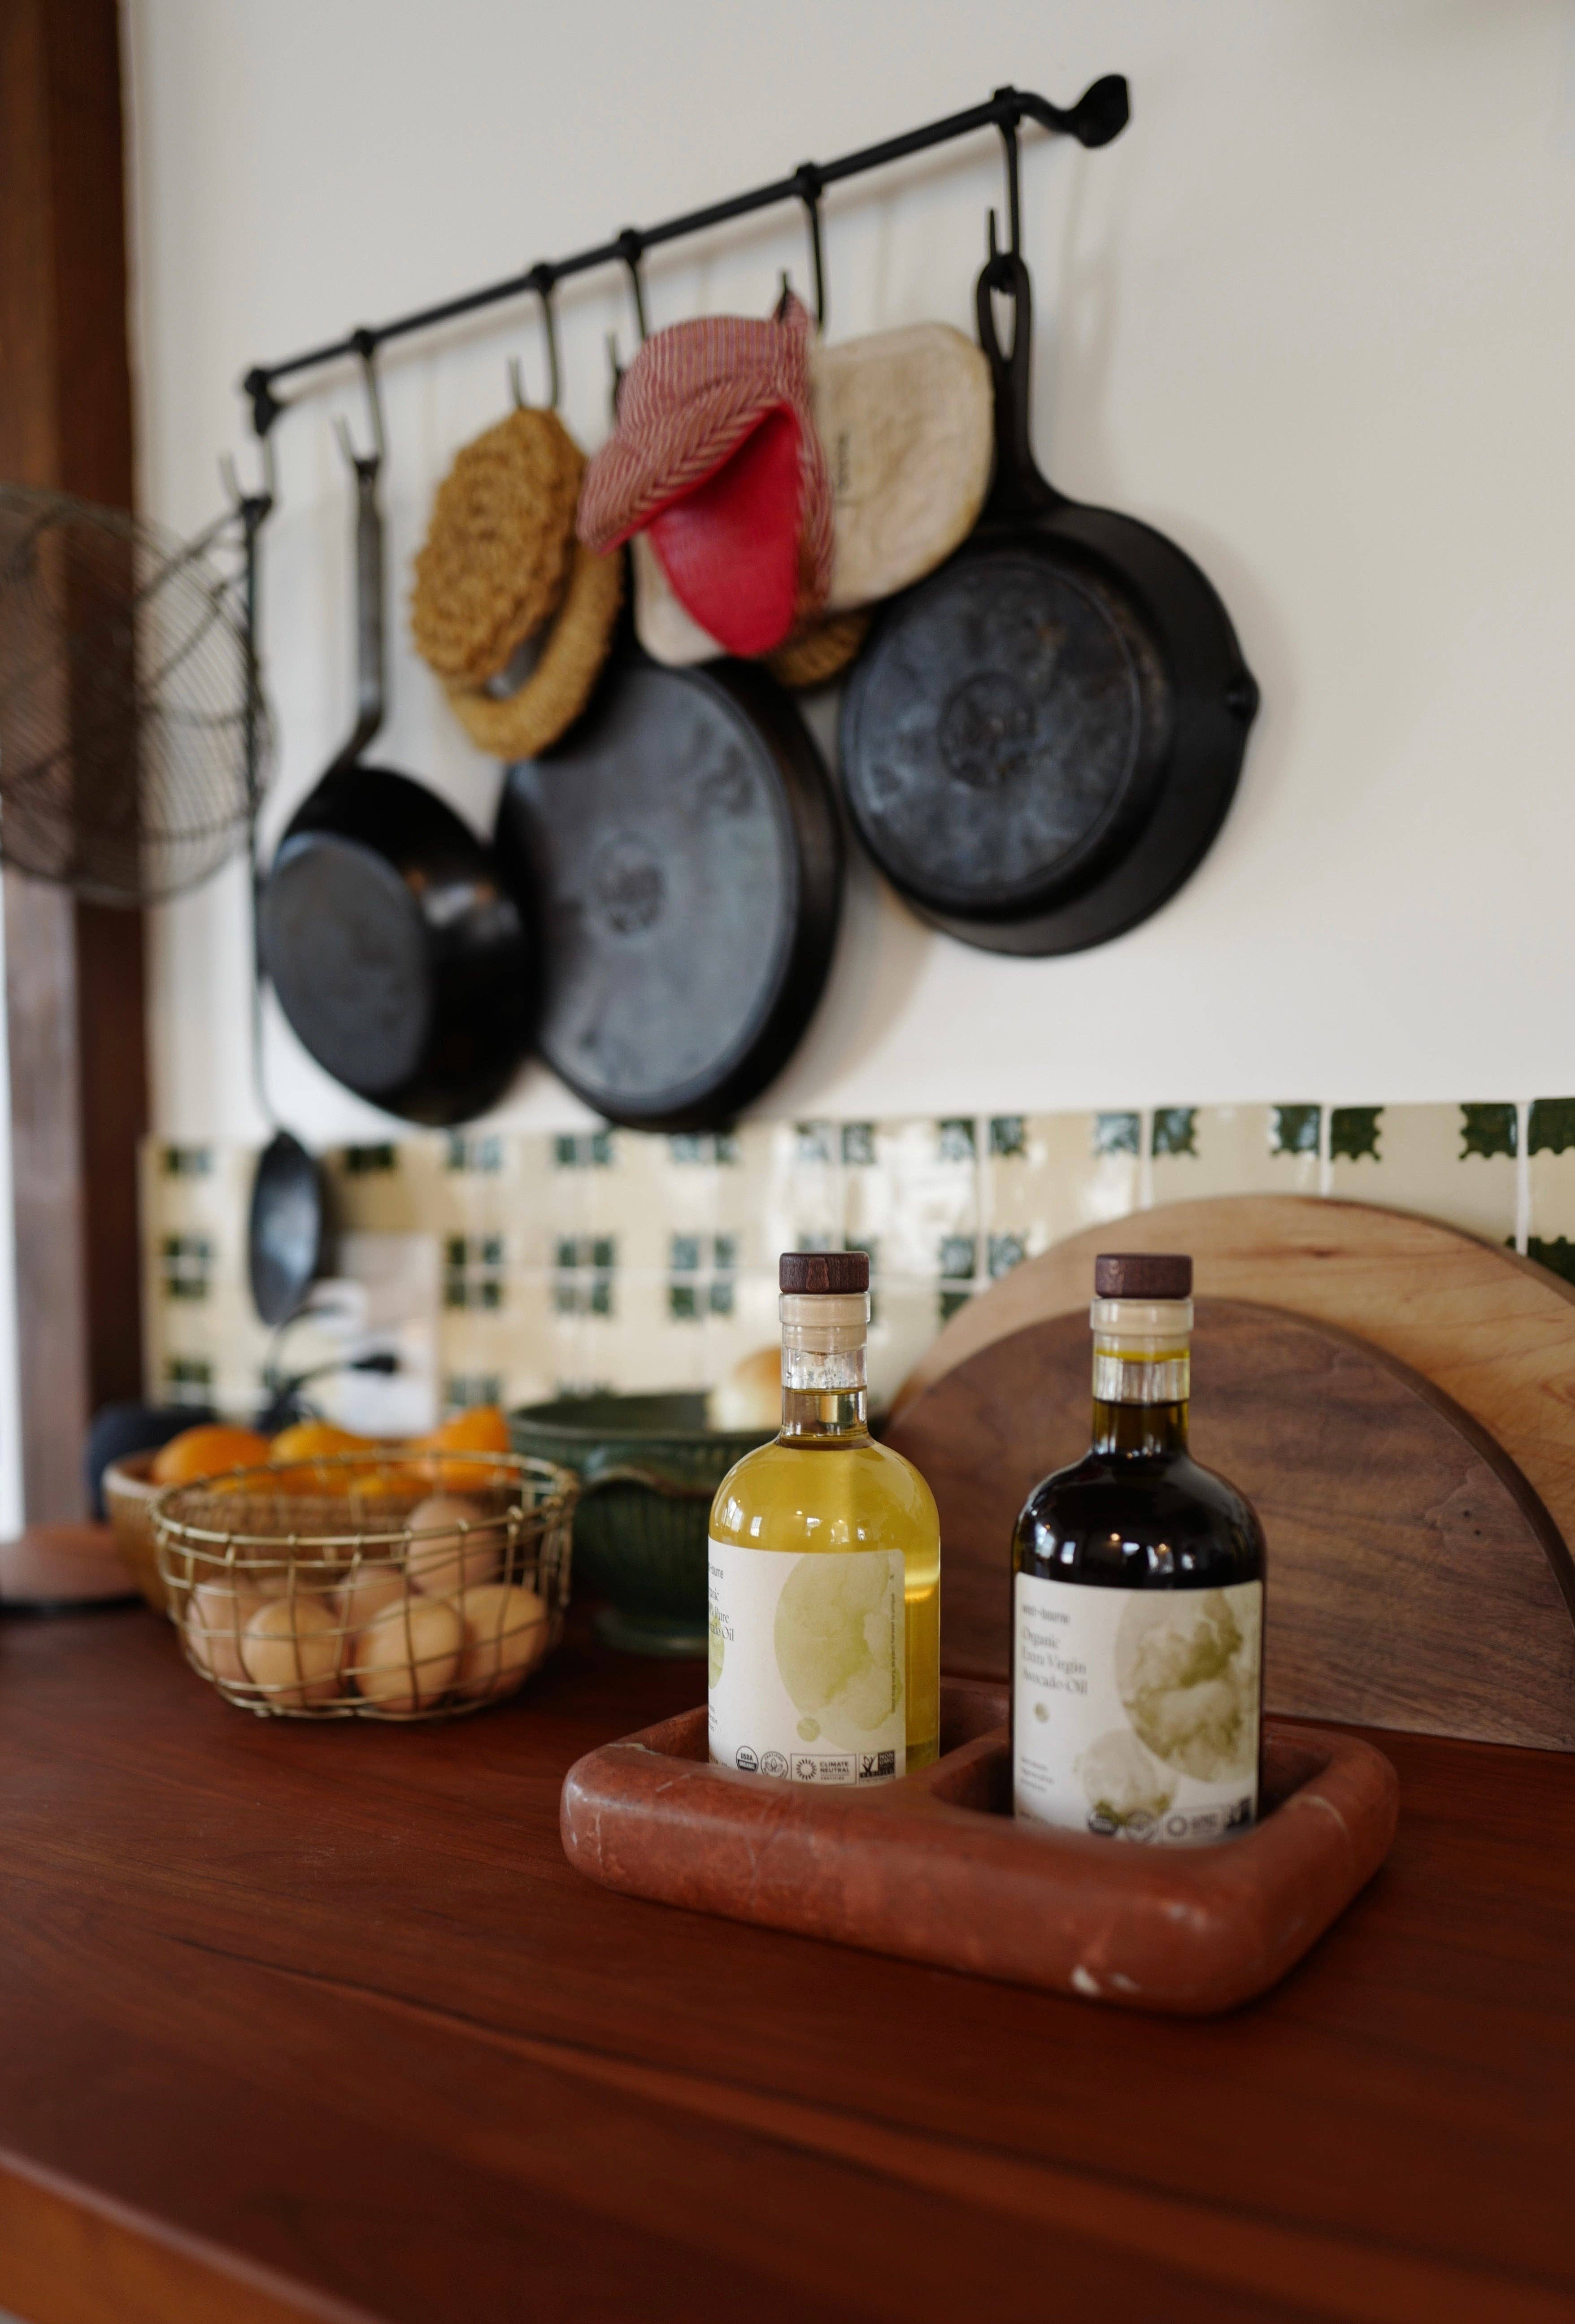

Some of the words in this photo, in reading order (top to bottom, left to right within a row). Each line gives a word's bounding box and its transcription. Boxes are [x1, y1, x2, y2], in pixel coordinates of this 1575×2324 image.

[715, 1607, 729, 1623] Pure
[722, 1626, 734, 1641] Oil
[740, 1753, 753, 1761] USDA
